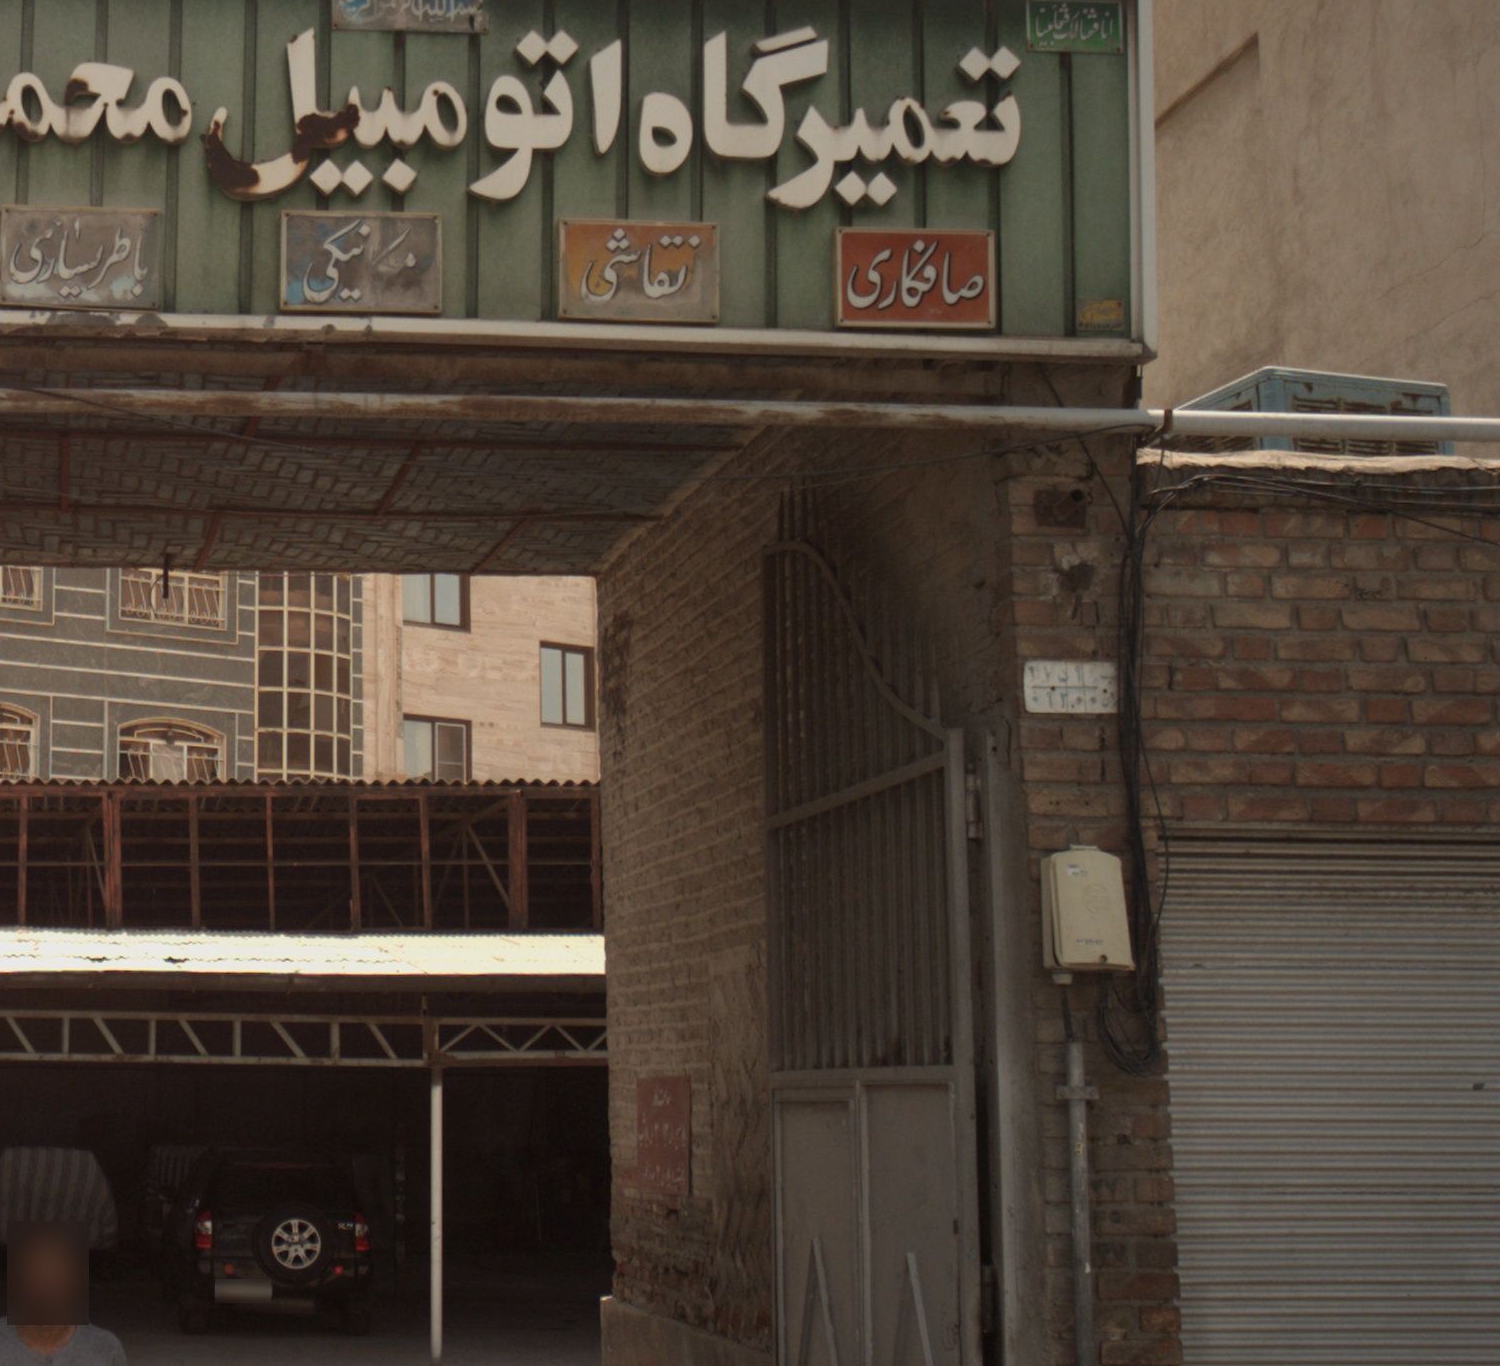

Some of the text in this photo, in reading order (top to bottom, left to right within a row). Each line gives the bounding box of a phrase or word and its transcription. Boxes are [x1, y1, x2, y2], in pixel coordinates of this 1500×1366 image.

[204, 27, 622, 203] اتومبیل
[639, 26, 1022, 212] تعمیرگاه
[581, 227, 700, 304] نقاشی
[847, 239, 985, 310] صافکاری
